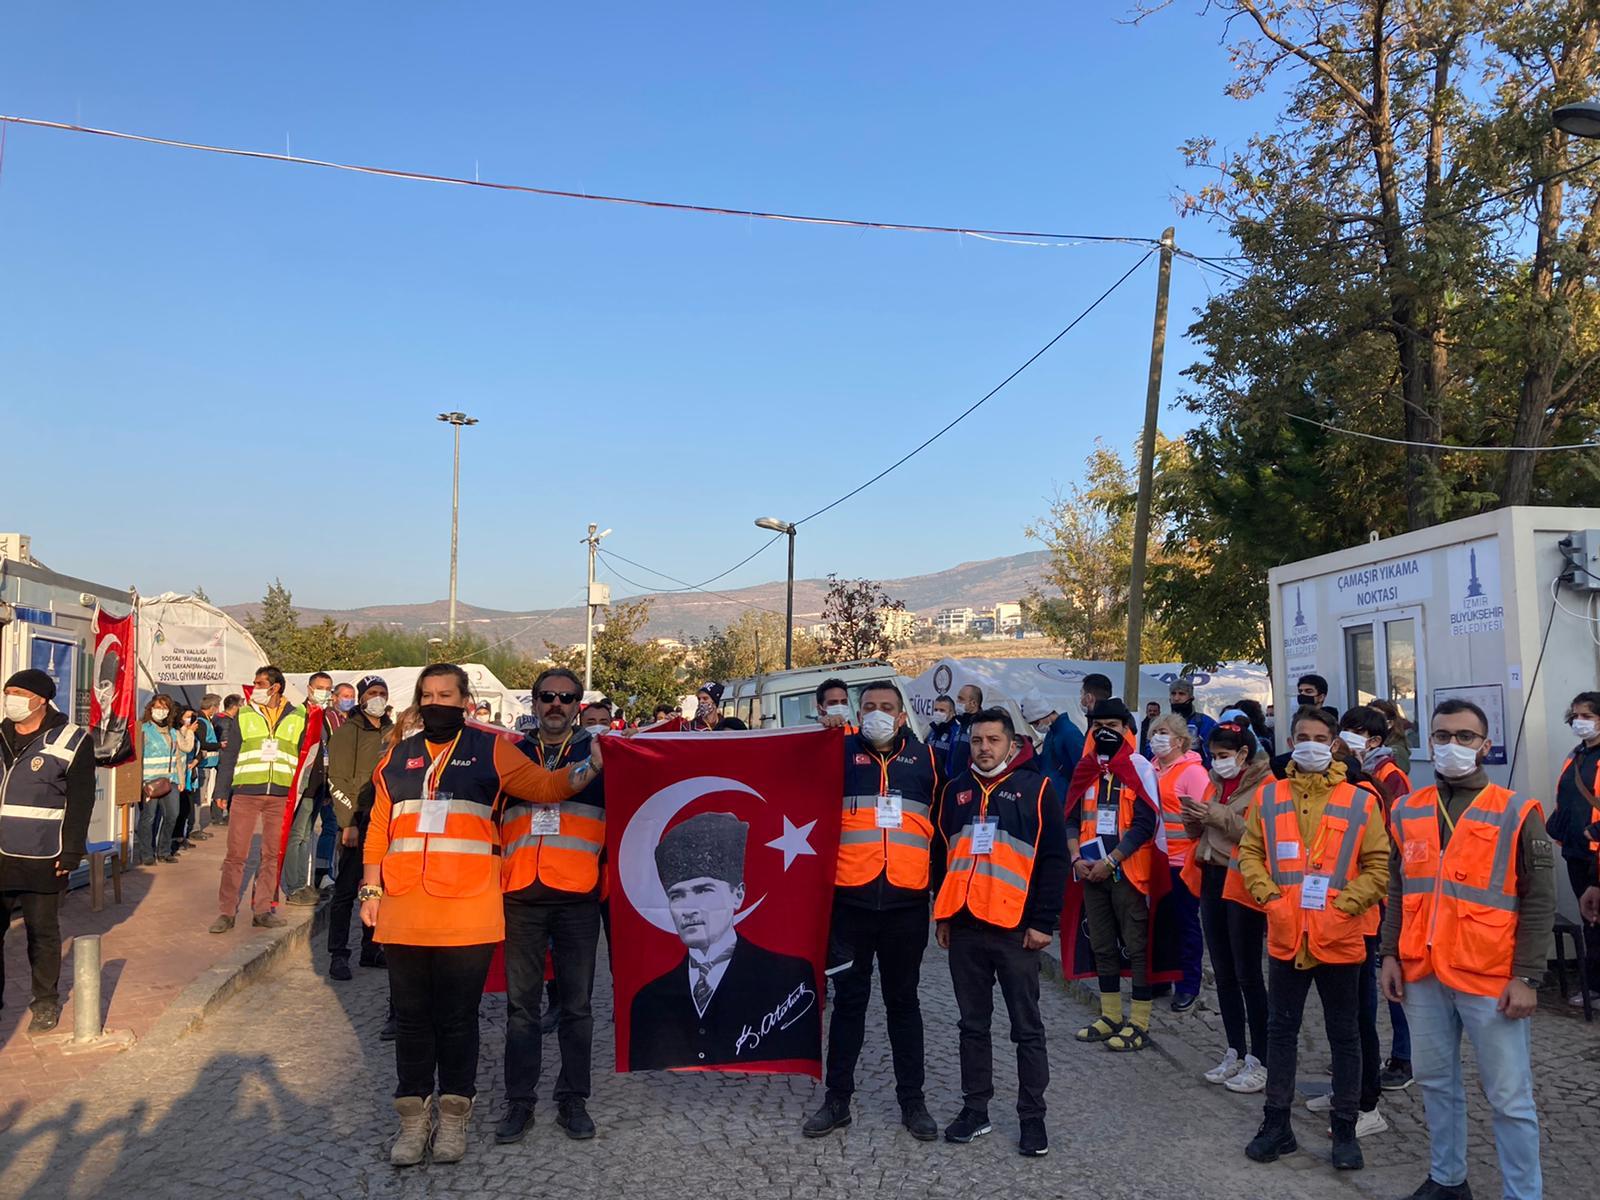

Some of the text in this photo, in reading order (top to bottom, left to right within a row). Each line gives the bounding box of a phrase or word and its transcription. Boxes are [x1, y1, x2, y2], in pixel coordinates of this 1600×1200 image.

[1337, 560, 1419, 592] ÇAMAŞIR YIKAMA
[1357, 586, 1398, 606] NOKTASI
[1511, 672, 1519, 681] 72
[450, 759, 472, 767] AFAD
[895, 755, 914, 765] AFAD
[998, 790, 1017, 801] AFAD
